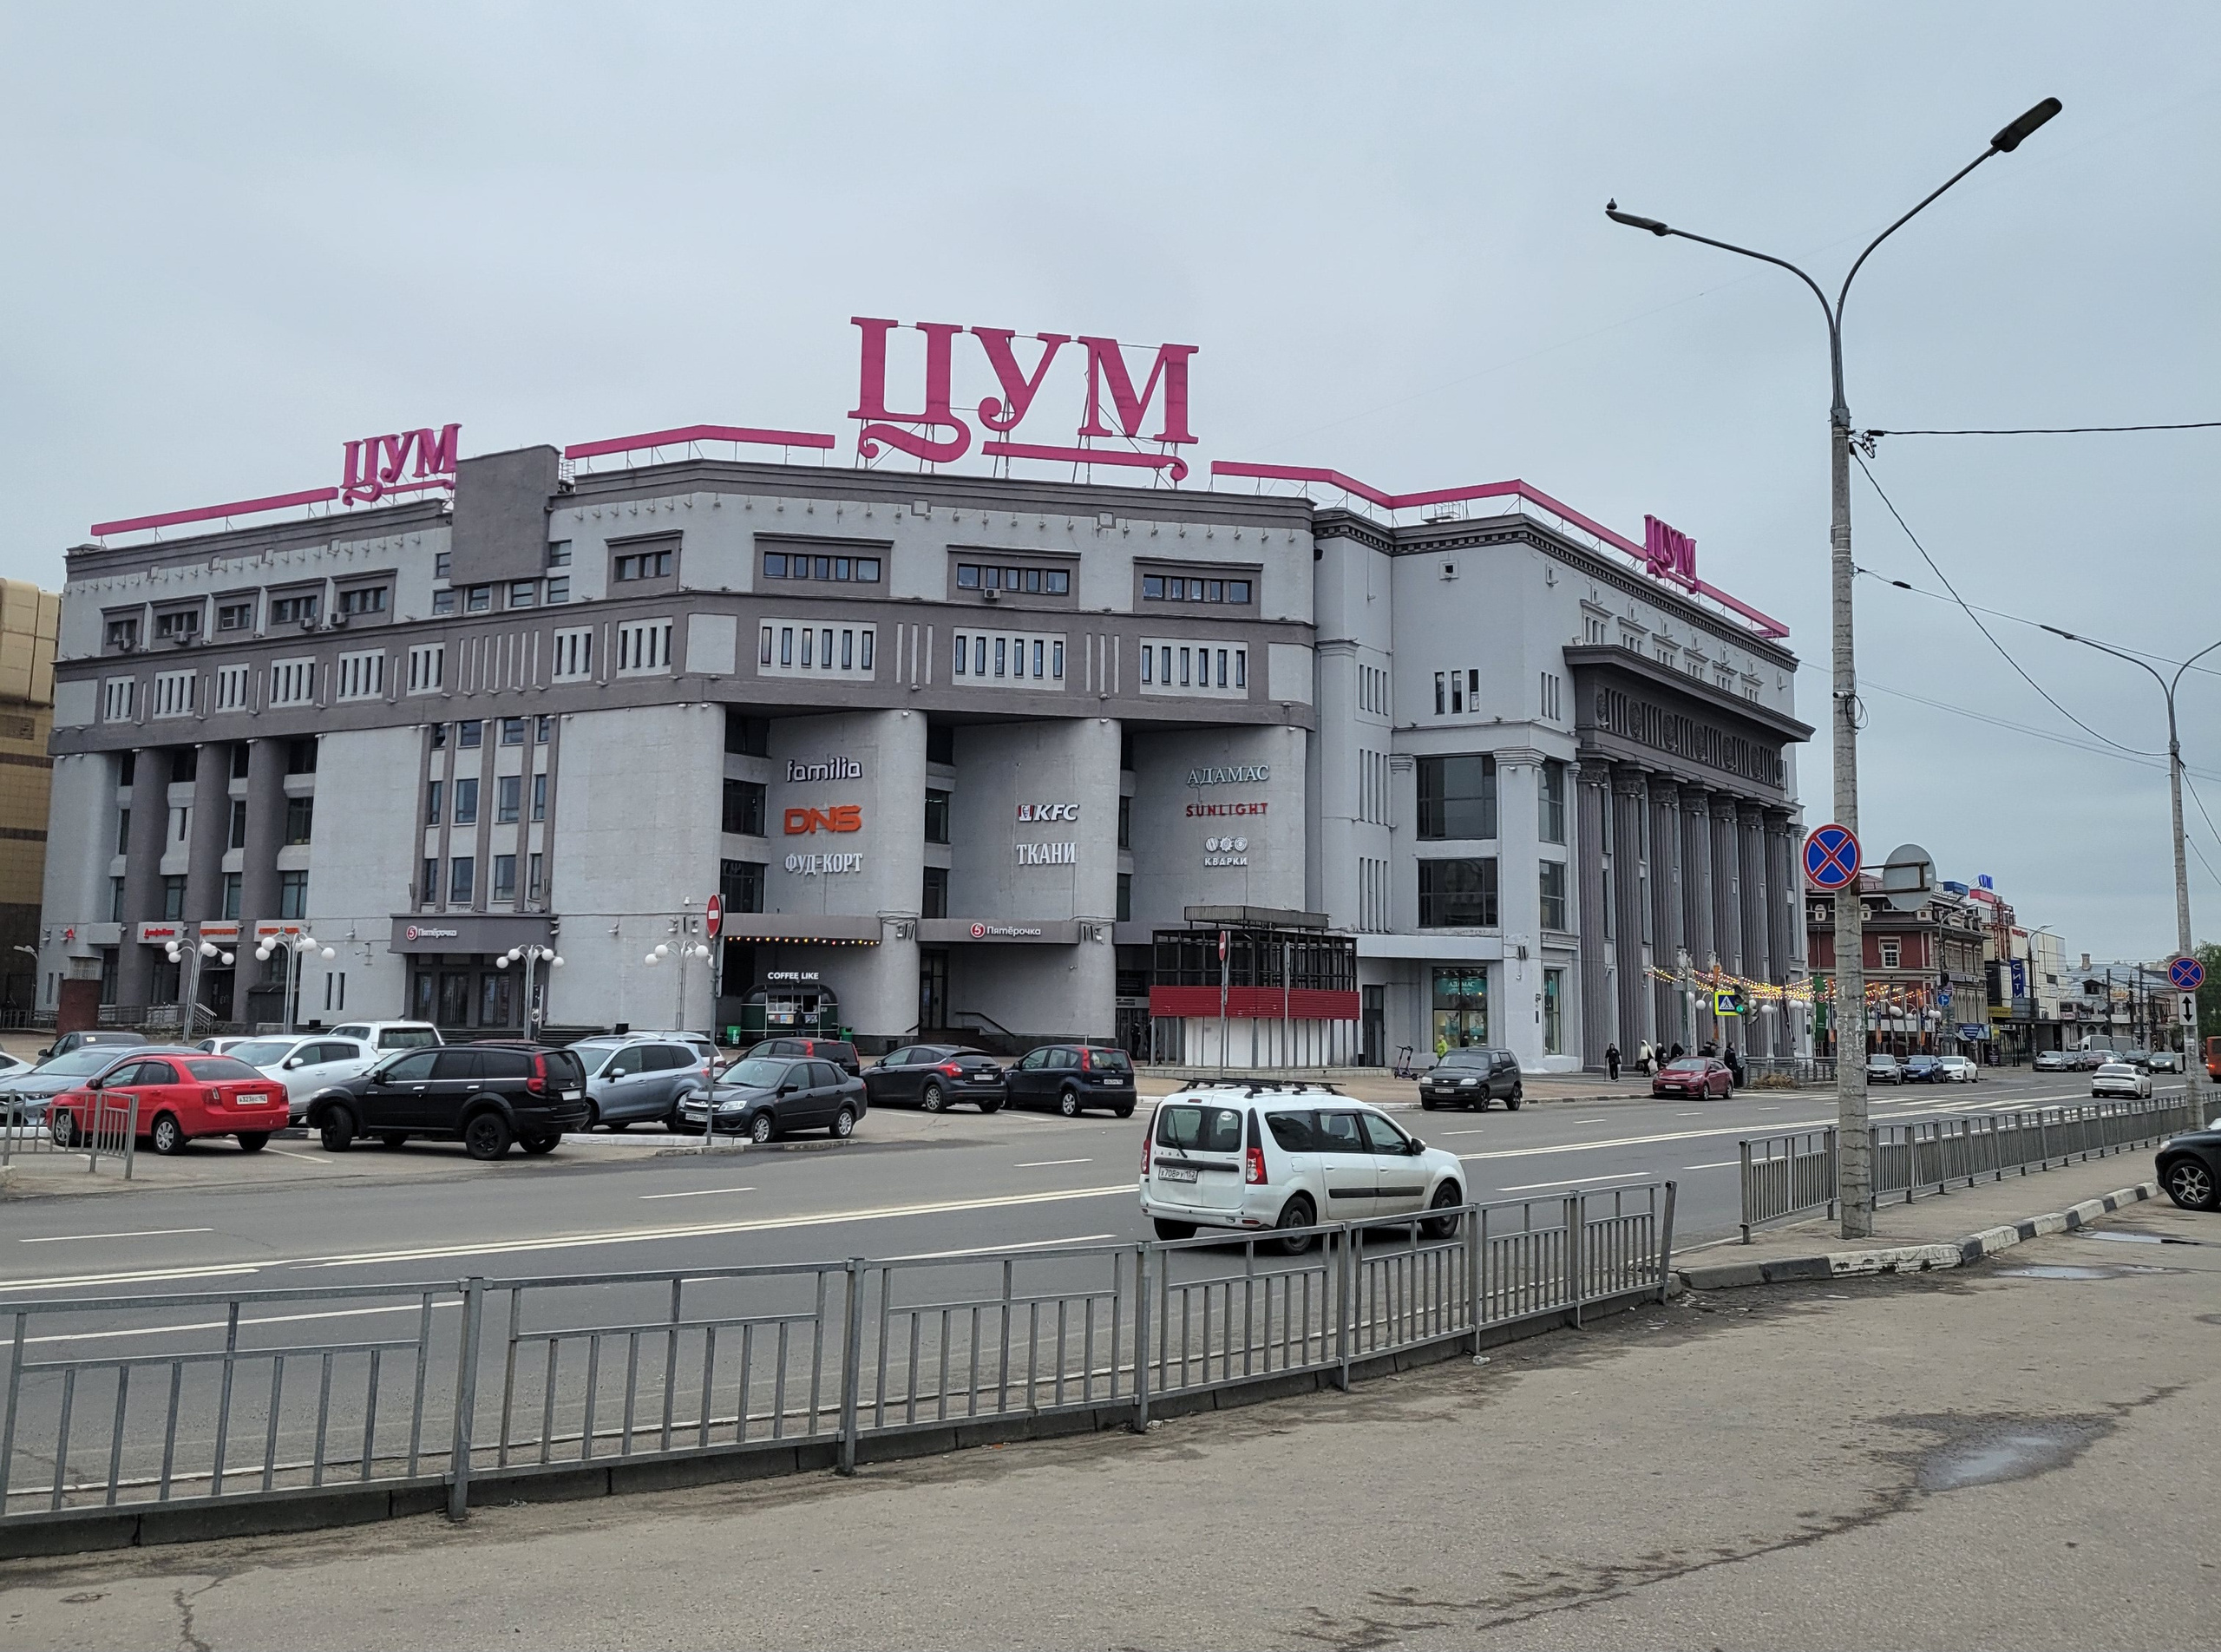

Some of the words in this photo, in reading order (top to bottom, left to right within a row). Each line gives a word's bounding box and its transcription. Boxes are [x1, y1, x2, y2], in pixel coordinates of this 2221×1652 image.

[848, 316, 1199, 481] ЦУМ
[339, 423, 462, 506] ЦУМ
[1643, 514, 1698, 594] ЦУМ
[786, 757, 862, 782] familia
[1186, 764, 1269, 785] АДАМАС
[783, 804, 862, 835] DNS
[1034, 803, 1080, 821] KFC
[1186, 802, 1268, 817] SUNLIGHT
[784, 853, 863, 876] ФУД-КОРТ
[1016, 842, 1077, 865] ТКАНИ
[1204, 856, 1248, 867] КВАРКИ
[986, 926, 1041, 937] Пятёрочка
